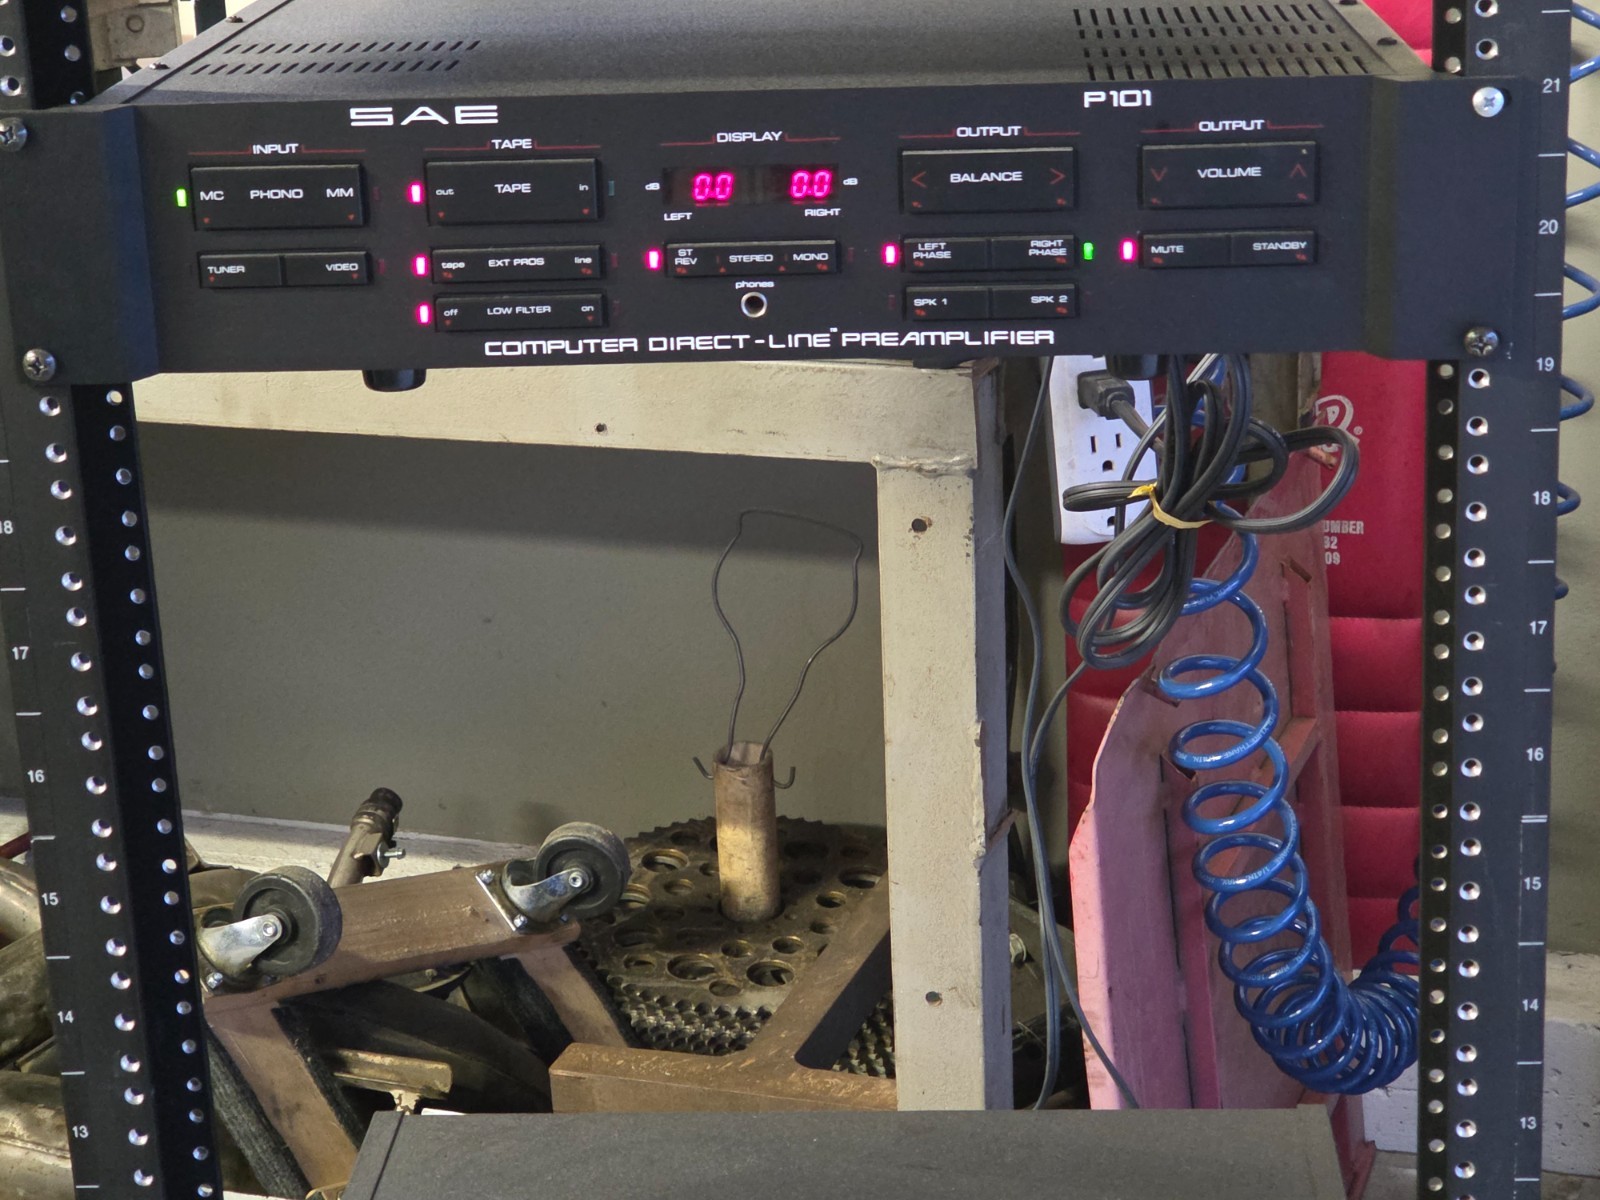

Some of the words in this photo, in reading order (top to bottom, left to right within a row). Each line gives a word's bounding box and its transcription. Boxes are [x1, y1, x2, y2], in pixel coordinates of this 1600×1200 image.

[1542, 78, 1561, 93] 21
[1083, 90, 1152, 108] P101
[349, 105, 499, 126] SAE
[956, 125, 1022, 138] OUTPUT
[1198, 119, 1265, 132] OUTPUT
[716, 130, 783, 143] DISPLAY
[252, 143, 299, 155] INPUT
[491, 138, 533, 150] TAPE
[949, 171, 1023, 183] BALANCE
[1197, 166, 1262, 179] VOLUME
[644, 182, 661, 191] dB
[842, 177, 859, 186] dB
[199, 190, 225, 201] MC
[249, 188, 304, 200] PHONO
[326, 187, 354, 198] MM
[435, 188, 455, 196] out
[494, 182, 532, 194] TAPE
[578, 183, 589, 191] in
[663, 212, 693, 222] LEFT
[804, 207, 842, 217] RIGHT
[1538, 220, 1559, 234] 20
[917, 242, 948, 251] LEFT
[1029, 239, 1064, 248] RIGHT
[1150, 245, 1184, 254] MUTE
[1252, 241, 1307, 251] STANDBY
[677, 248, 694, 257] ST
[728, 253, 774, 263] STEREO
[792, 252, 829, 262] MONO
[912, 250, 952, 259] PHASE
[1028, 247, 1067, 257] PHASE
[441, 261, 466, 270] tape
[488, 258, 511, 268] EXT
[512, 257, 545, 266] PROS
[574, 256, 593, 264] line
[674, 257, 698, 266] REV
[207, 265, 246, 274] TUNER
[325, 262, 359, 272] VIDEO
[734, 280, 776, 290] phones
[913, 298, 937, 307] SPK
[941, 297, 948, 306] 1
[1030, 295, 1055, 304] SPK
[1058, 294, 1068, 303] 2
[443, 308, 459, 317] off
[486, 306, 513, 316] LOW
[515, 305, 552, 314] FILTER
[484, 338, 639, 355] COMPUTER
[841, 330, 1055, 346] PREAMPLIFIER
[1536, 357, 1555, 371] 19
[1532, 491, 1551, 505] 18
[1323, 520, 1364, 534] UMBER
[1529, 620, 1548, 635] 17
[12, 646, 30, 660] 17
[1526, 747, 1544, 761] 16
[27, 769, 45, 783] 16
[1523, 876, 1542, 891] 15
[40, 892, 59, 906] 15
[1522, 998, 1539, 1012] 14
[57, 1010, 74, 1024] 14
[1519, 1116, 1537, 1130] 13
[71, 1125, 89, 1139] 13
